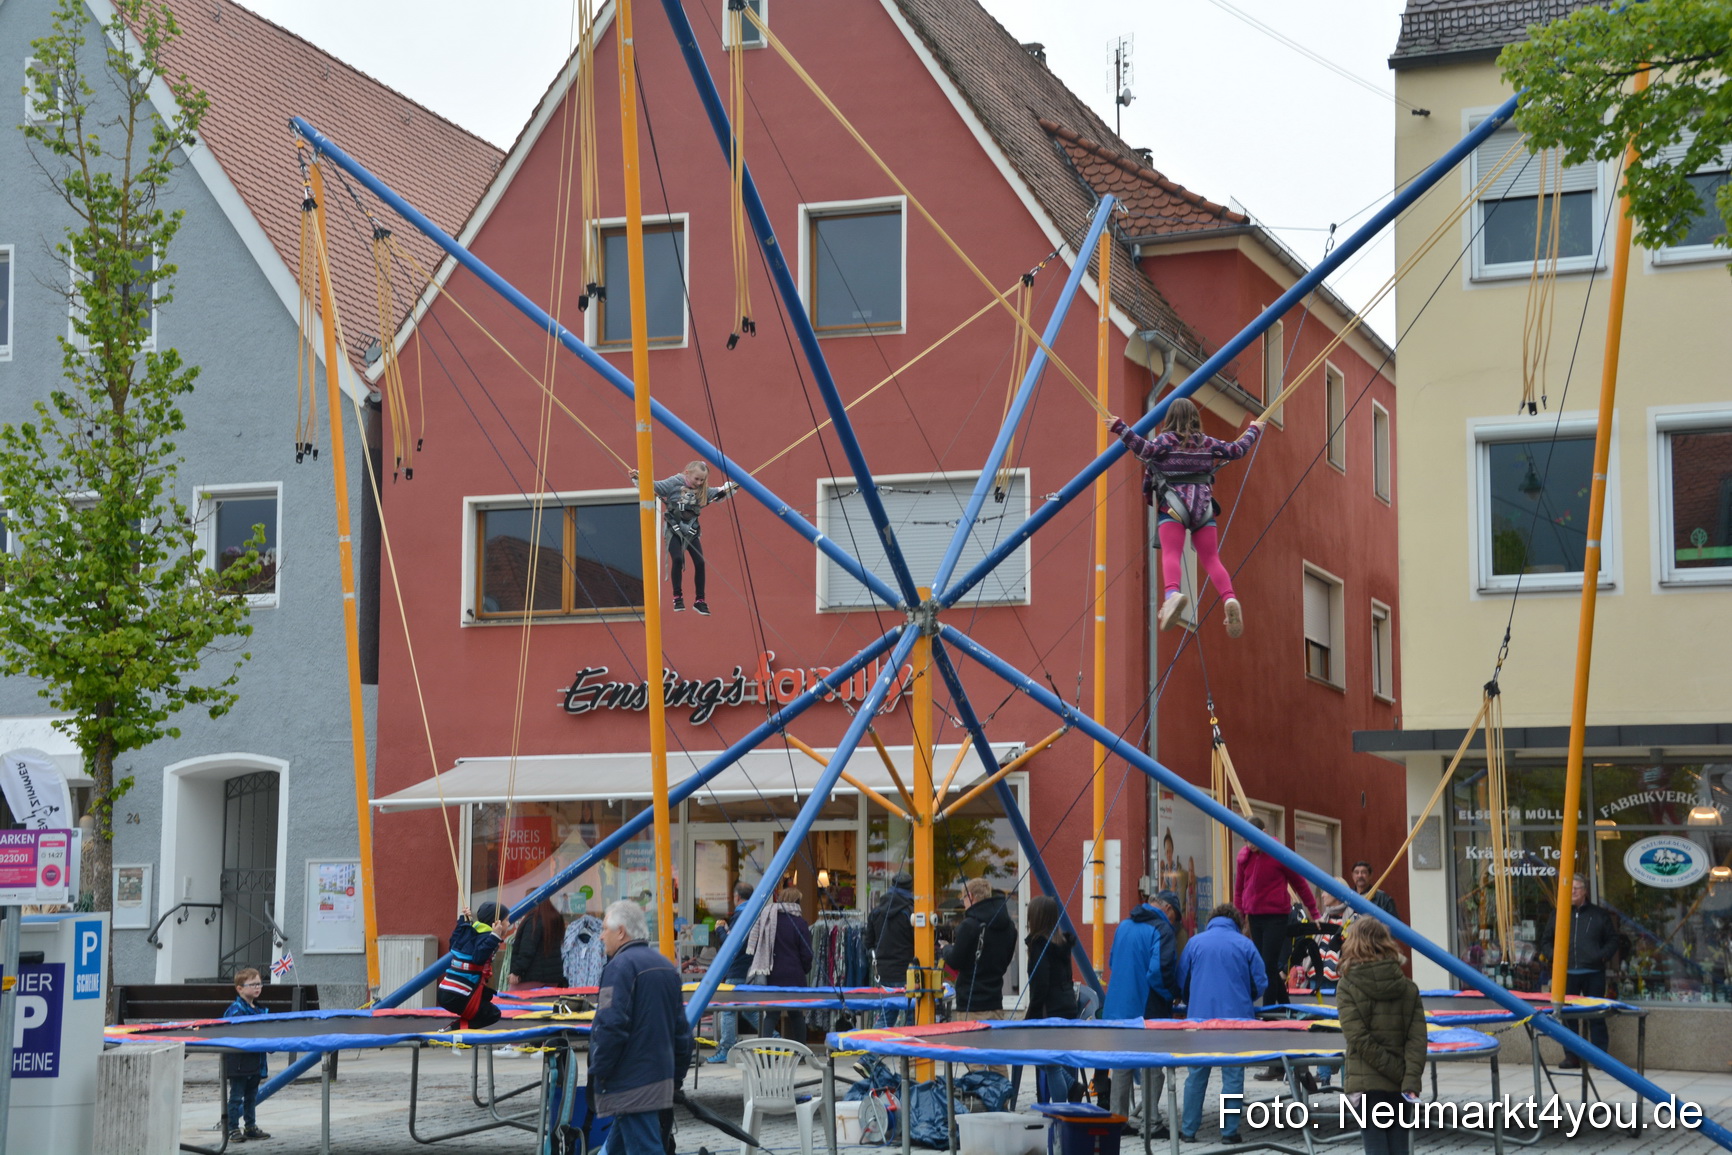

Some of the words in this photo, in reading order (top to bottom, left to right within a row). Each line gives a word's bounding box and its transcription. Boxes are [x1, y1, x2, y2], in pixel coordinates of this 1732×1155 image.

[126, 812, 140, 825] 24
[509, 829, 541, 844] PREIS
[504, 847, 546, 861] RUTSCH
[1465, 845, 1526, 860] Kräter
[1540, 845, 1579, 860] Tes
[81, 931, 98, 966] P
[16, 973, 53, 992] IER
[76, 973, 100, 993] SCHEINE
[13, 995, 48, 1048] P
[12, 1052, 53, 1072] HEINE
